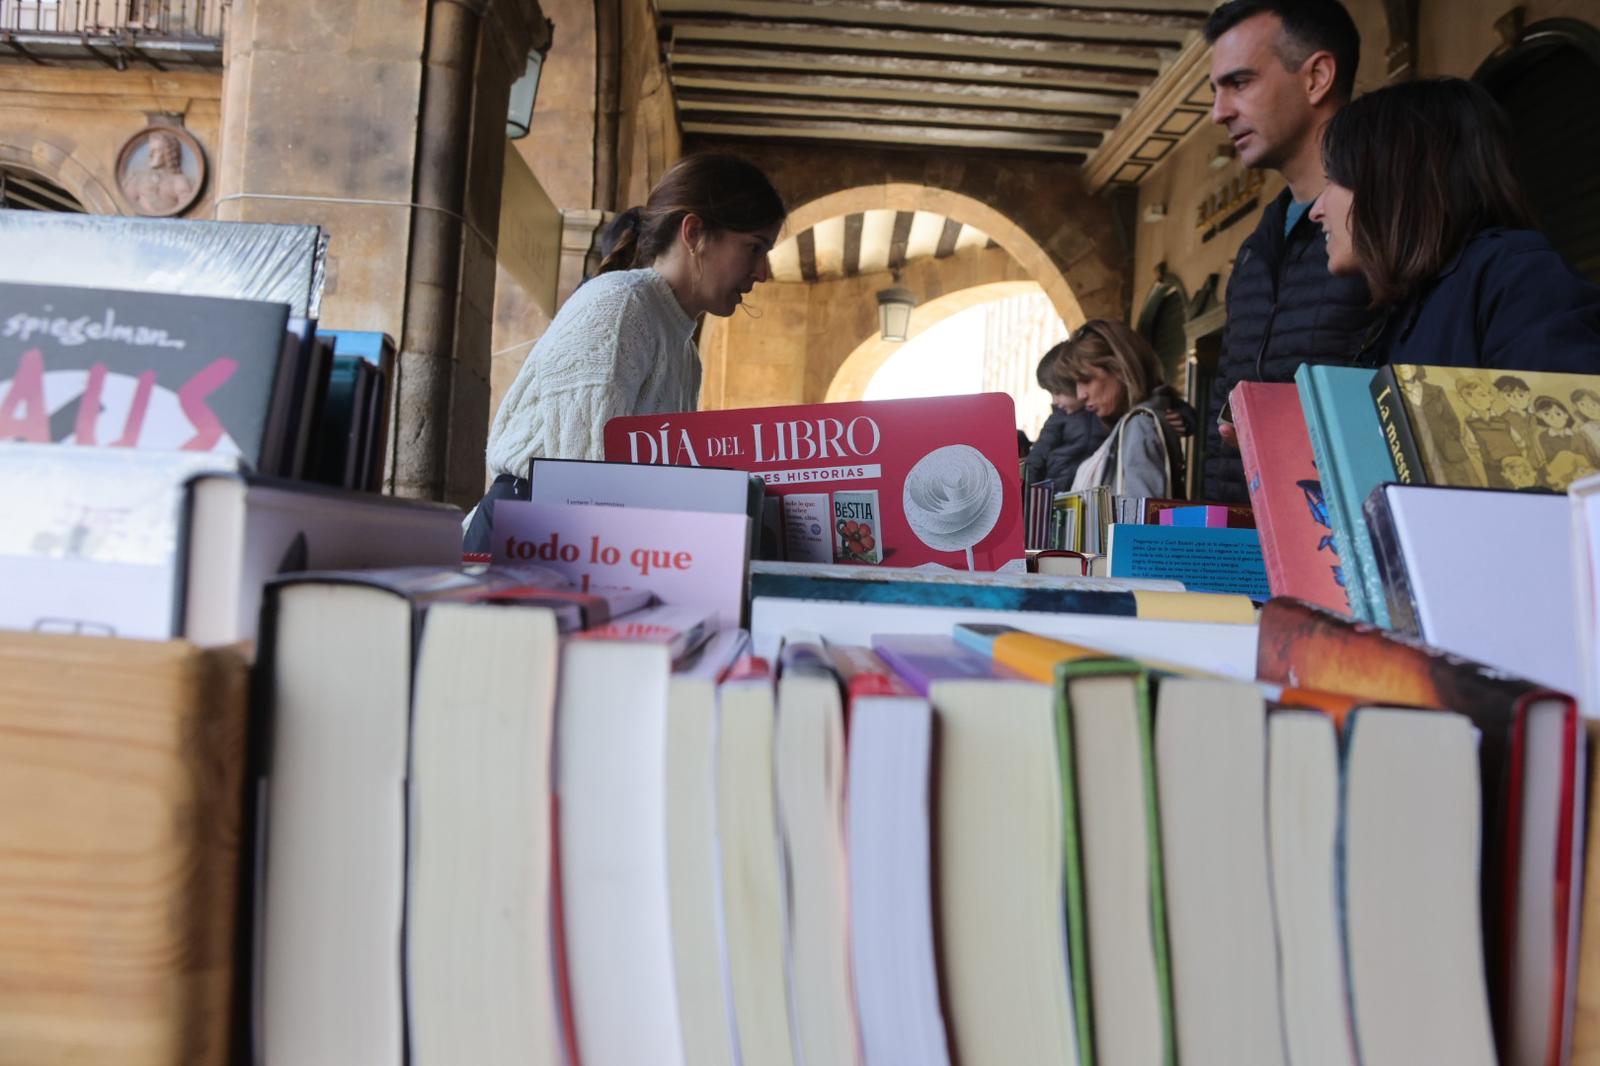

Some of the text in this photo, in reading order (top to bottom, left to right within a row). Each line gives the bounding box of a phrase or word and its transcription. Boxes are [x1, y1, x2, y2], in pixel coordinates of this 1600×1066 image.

[1376, 384, 1391, 423] La
[627, 416, 881, 467] DÍA DEL LIBRO
[787, 467, 864, 482] HISTORIAS
[834, 501, 873, 520] BESTIA
[506, 532, 693, 576] todo lo que
